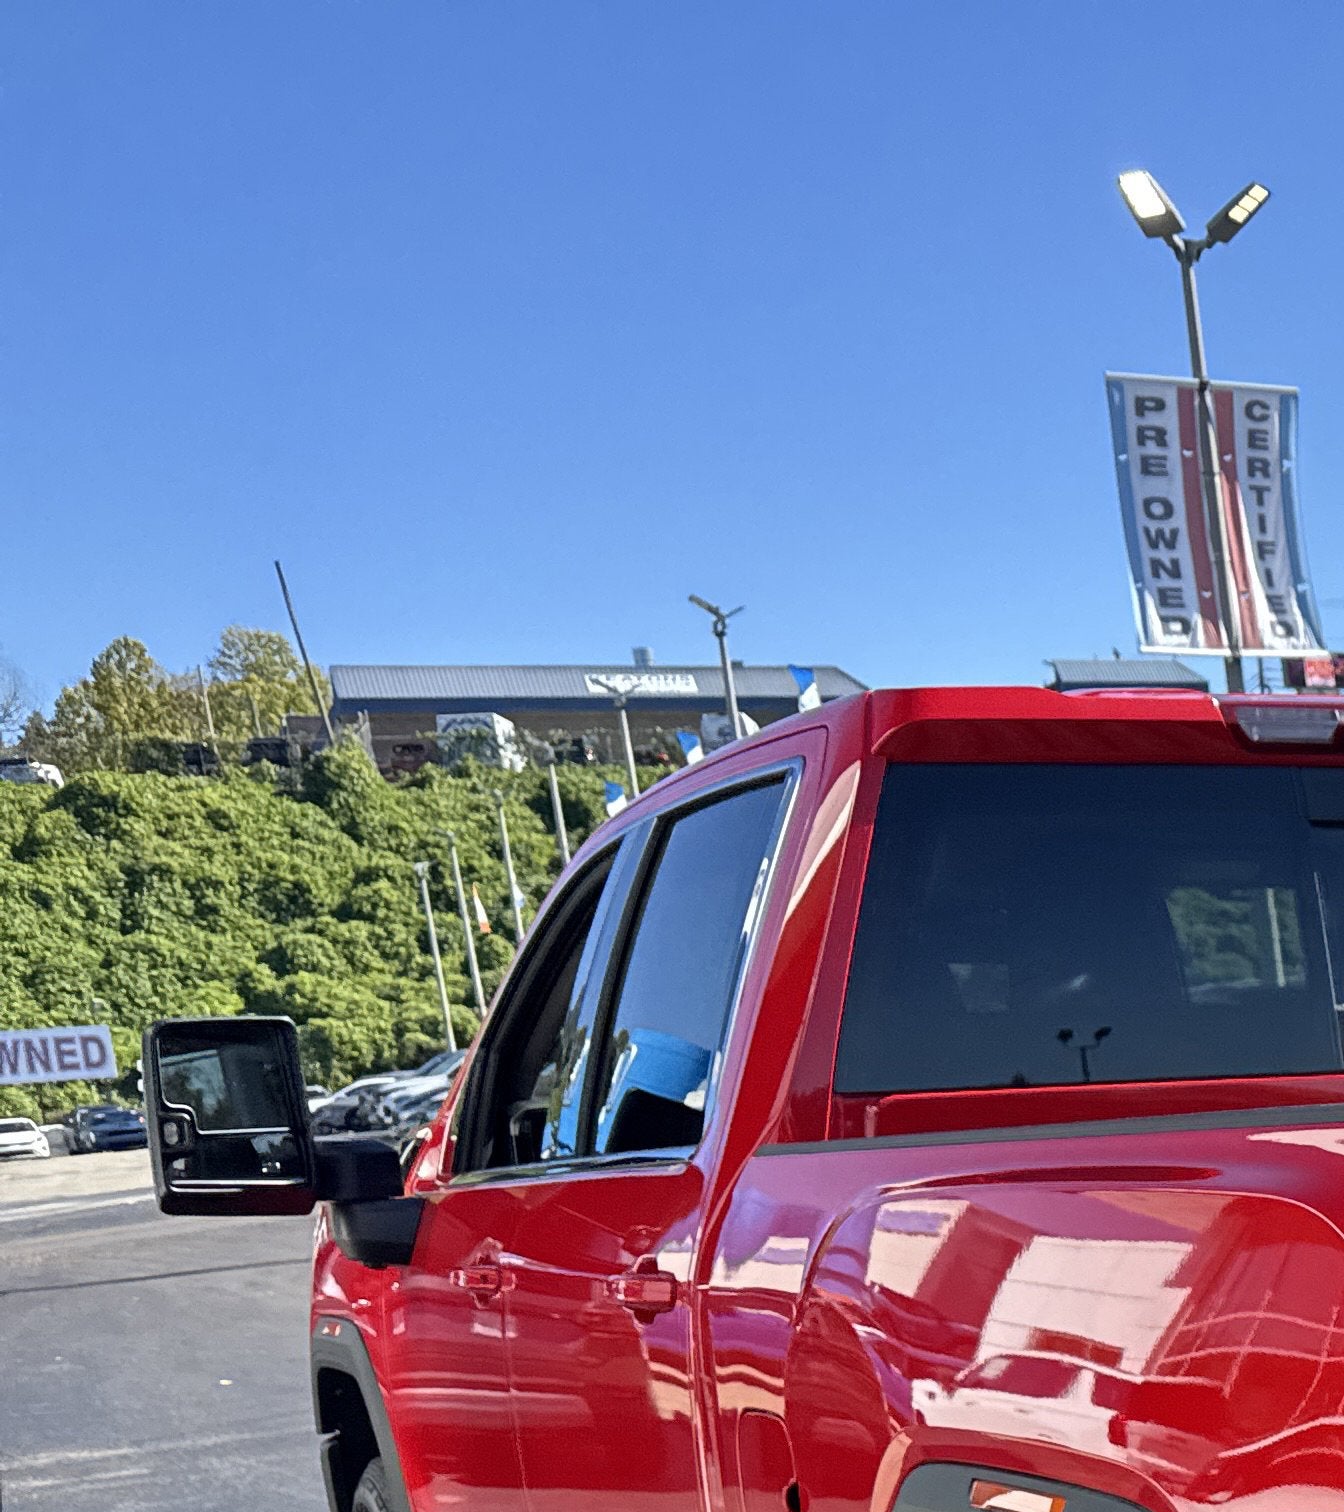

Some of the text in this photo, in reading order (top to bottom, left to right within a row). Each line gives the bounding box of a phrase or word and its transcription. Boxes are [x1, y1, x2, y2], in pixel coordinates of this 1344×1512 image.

[1134, 396, 1192, 636] PRE OWNED
[1244, 400, 1294, 638] CERTIFIED
